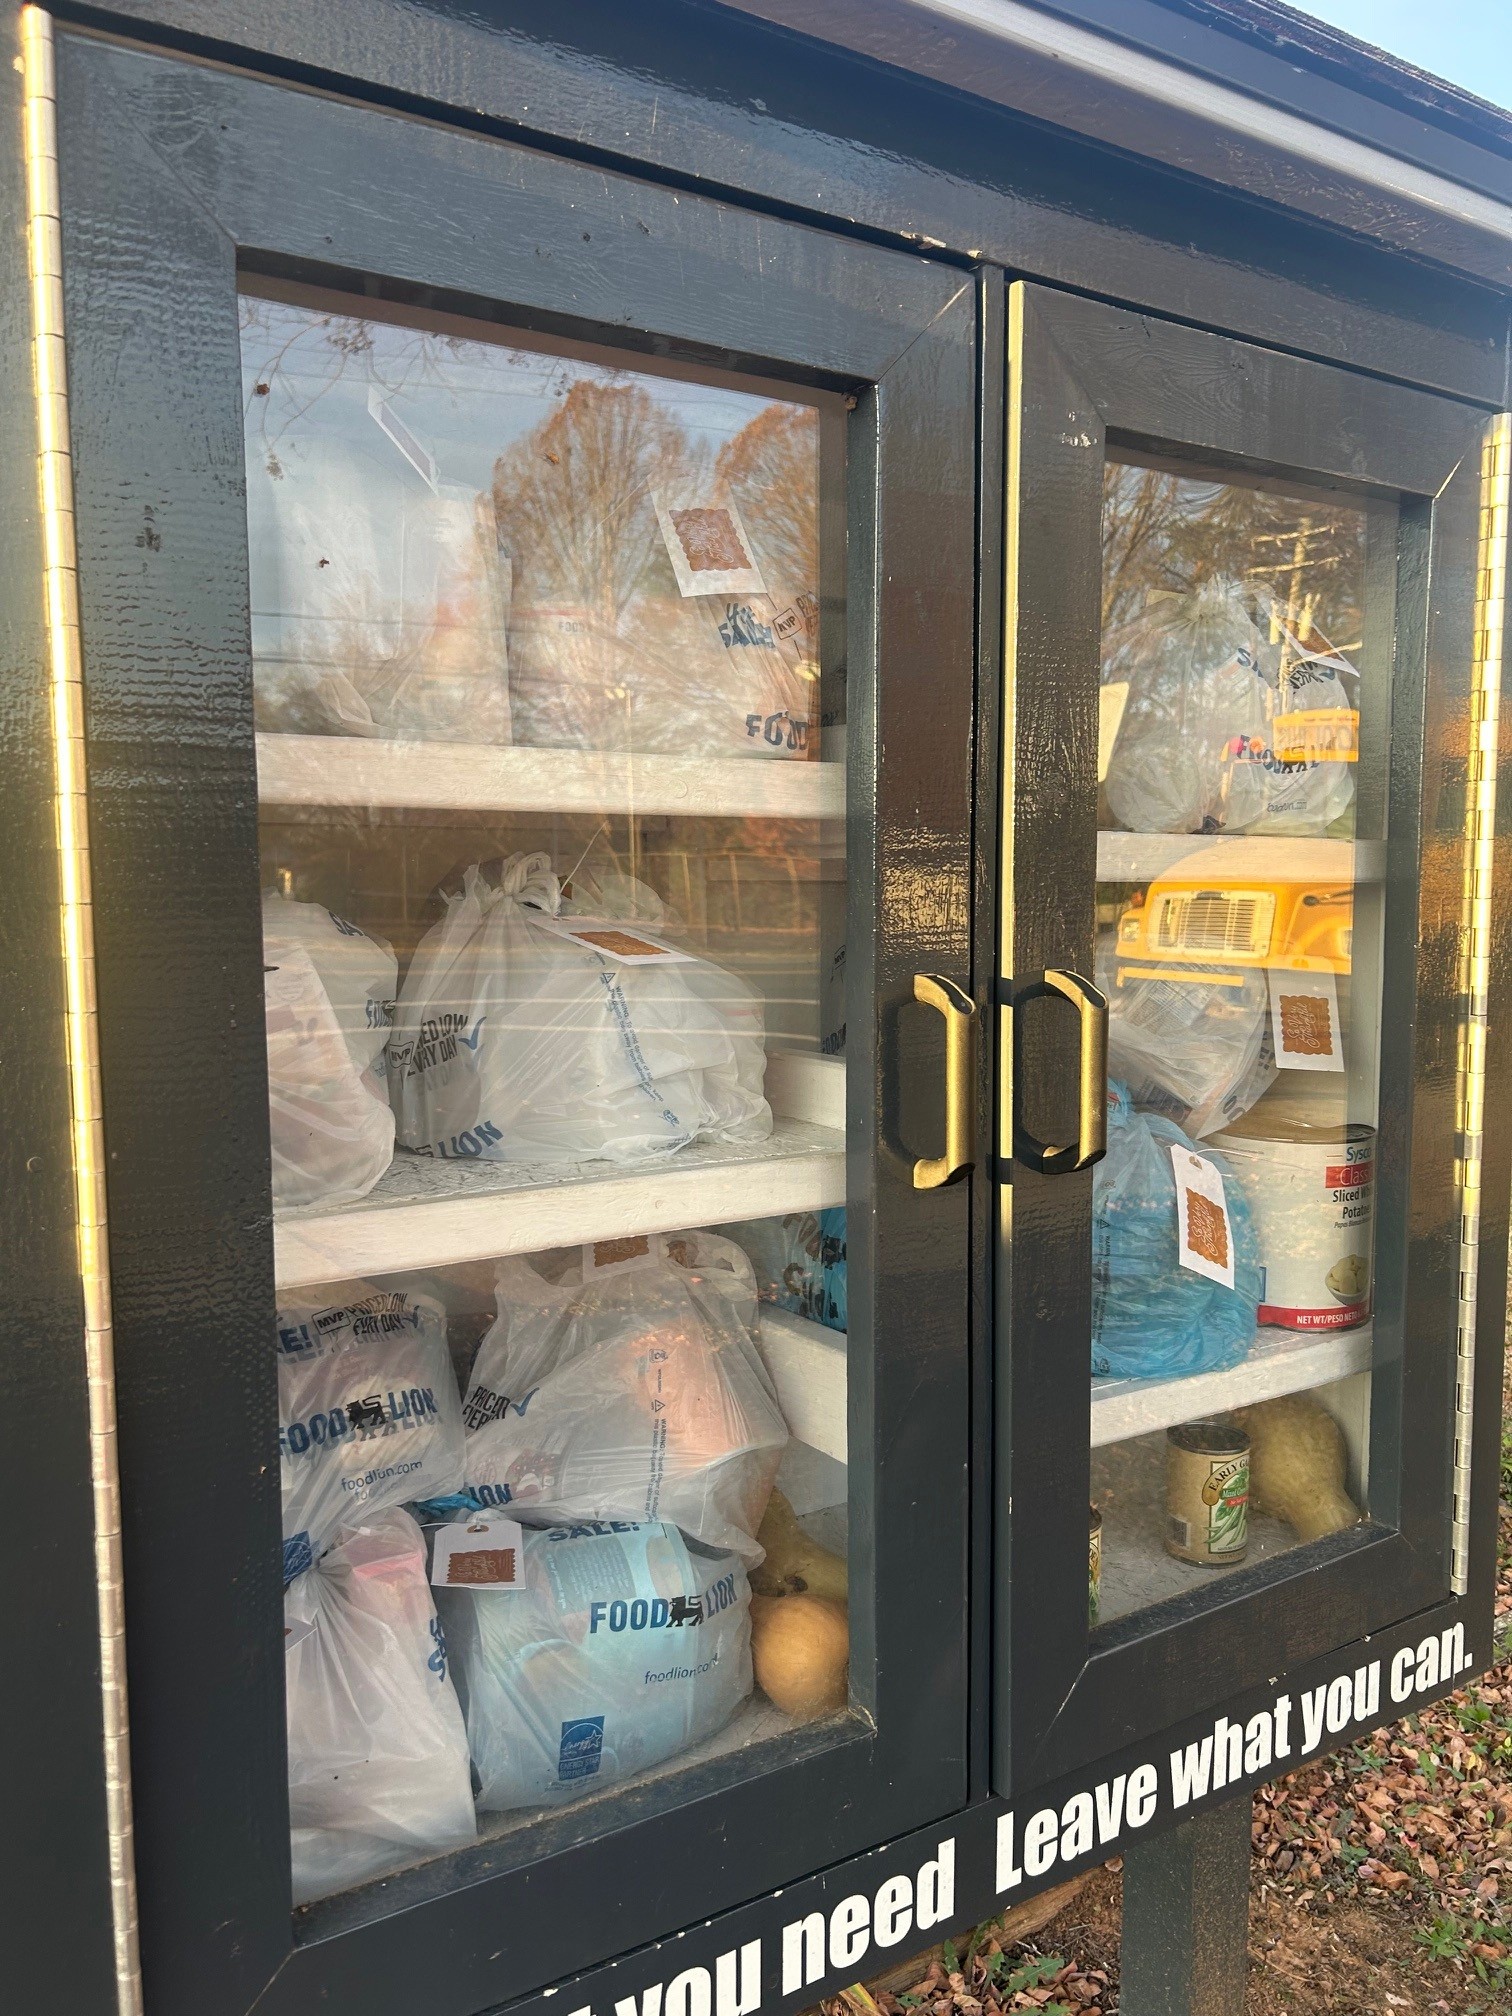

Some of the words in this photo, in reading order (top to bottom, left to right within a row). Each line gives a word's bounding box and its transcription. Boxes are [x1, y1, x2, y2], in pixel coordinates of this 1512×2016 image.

[438, 1013, 469, 1038] LOW
[438, 1034, 459, 1063] DAY
[1332, 1185, 1360, 1203] Sliced
[317, 1311, 345, 1329] MVP
[380, 1313, 406, 1333] DAY
[1296, 1315, 1311, 1325] NET
[1312, 1313, 1344, 1325] WT/PESO
[277, 1324, 314, 1354] E!
[387, 1387, 439, 1421] LION
[1208, 1462, 1239, 1492] EARLY
[547, 1520, 641, 1542] SALE!
[589, 1598, 670, 1634] FOOD
[705, 1572, 738, 1619] LION
[995, 1763, 1159, 1895] Leave
[1170, 1694, 1292, 1810] what
[1300, 1659, 1381, 1756] you
[1390, 1620, 1473, 1703] can.
[781, 1836, 956, 1997] need
